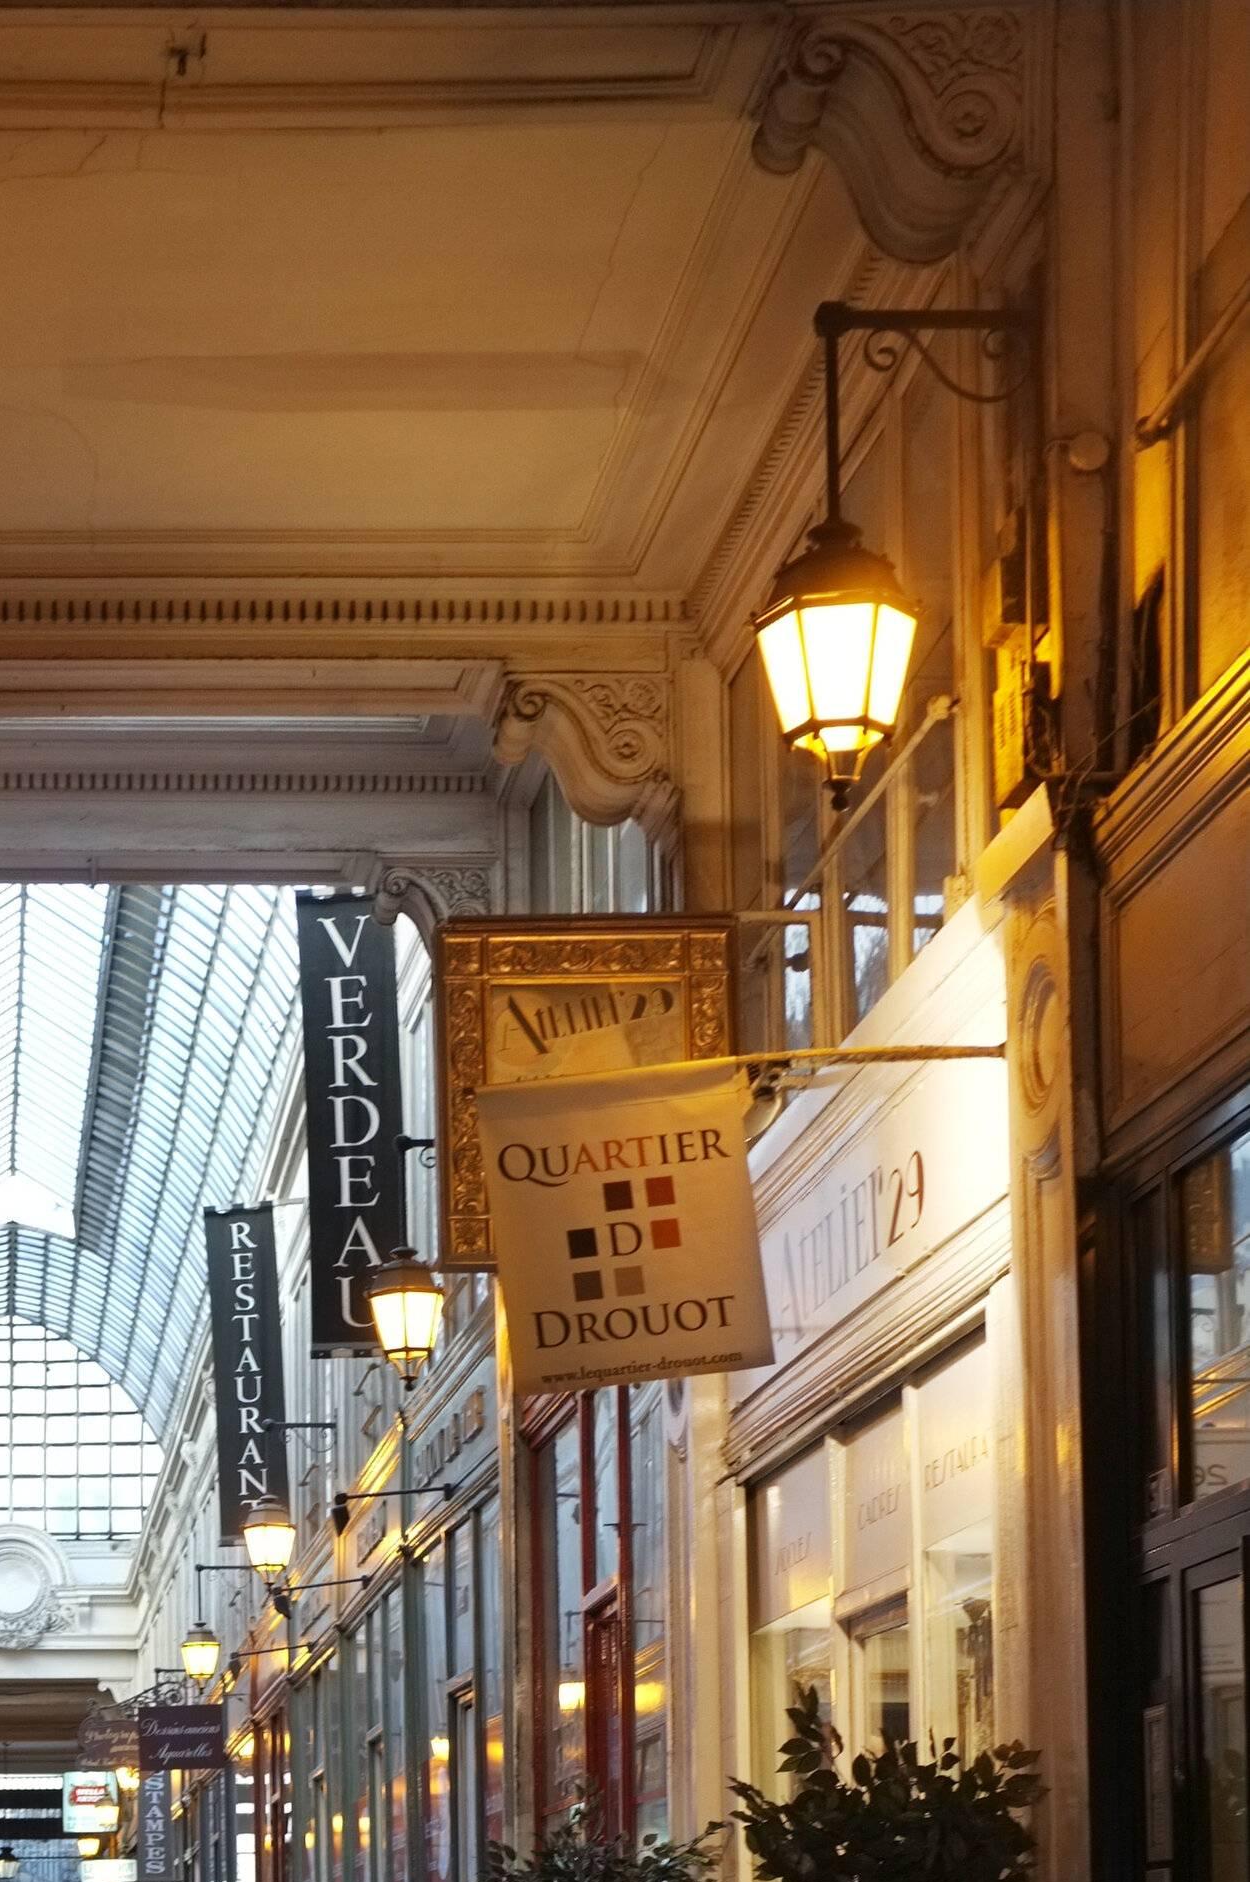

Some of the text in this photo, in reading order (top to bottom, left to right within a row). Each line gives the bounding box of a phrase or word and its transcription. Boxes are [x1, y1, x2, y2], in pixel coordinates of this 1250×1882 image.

[316, 914, 384, 1329] VERDEAU
[497, 1128, 733, 1188] QUARTIER
[887, 1150, 925, 1249] 29
[607, 1220, 643, 1258] D
[531, 1294, 735, 1350] DROUOT
[541, 1350, 743, 1385] www.lequartier-drouot.com
[144, 1771, 166, 1875] STAMPES
